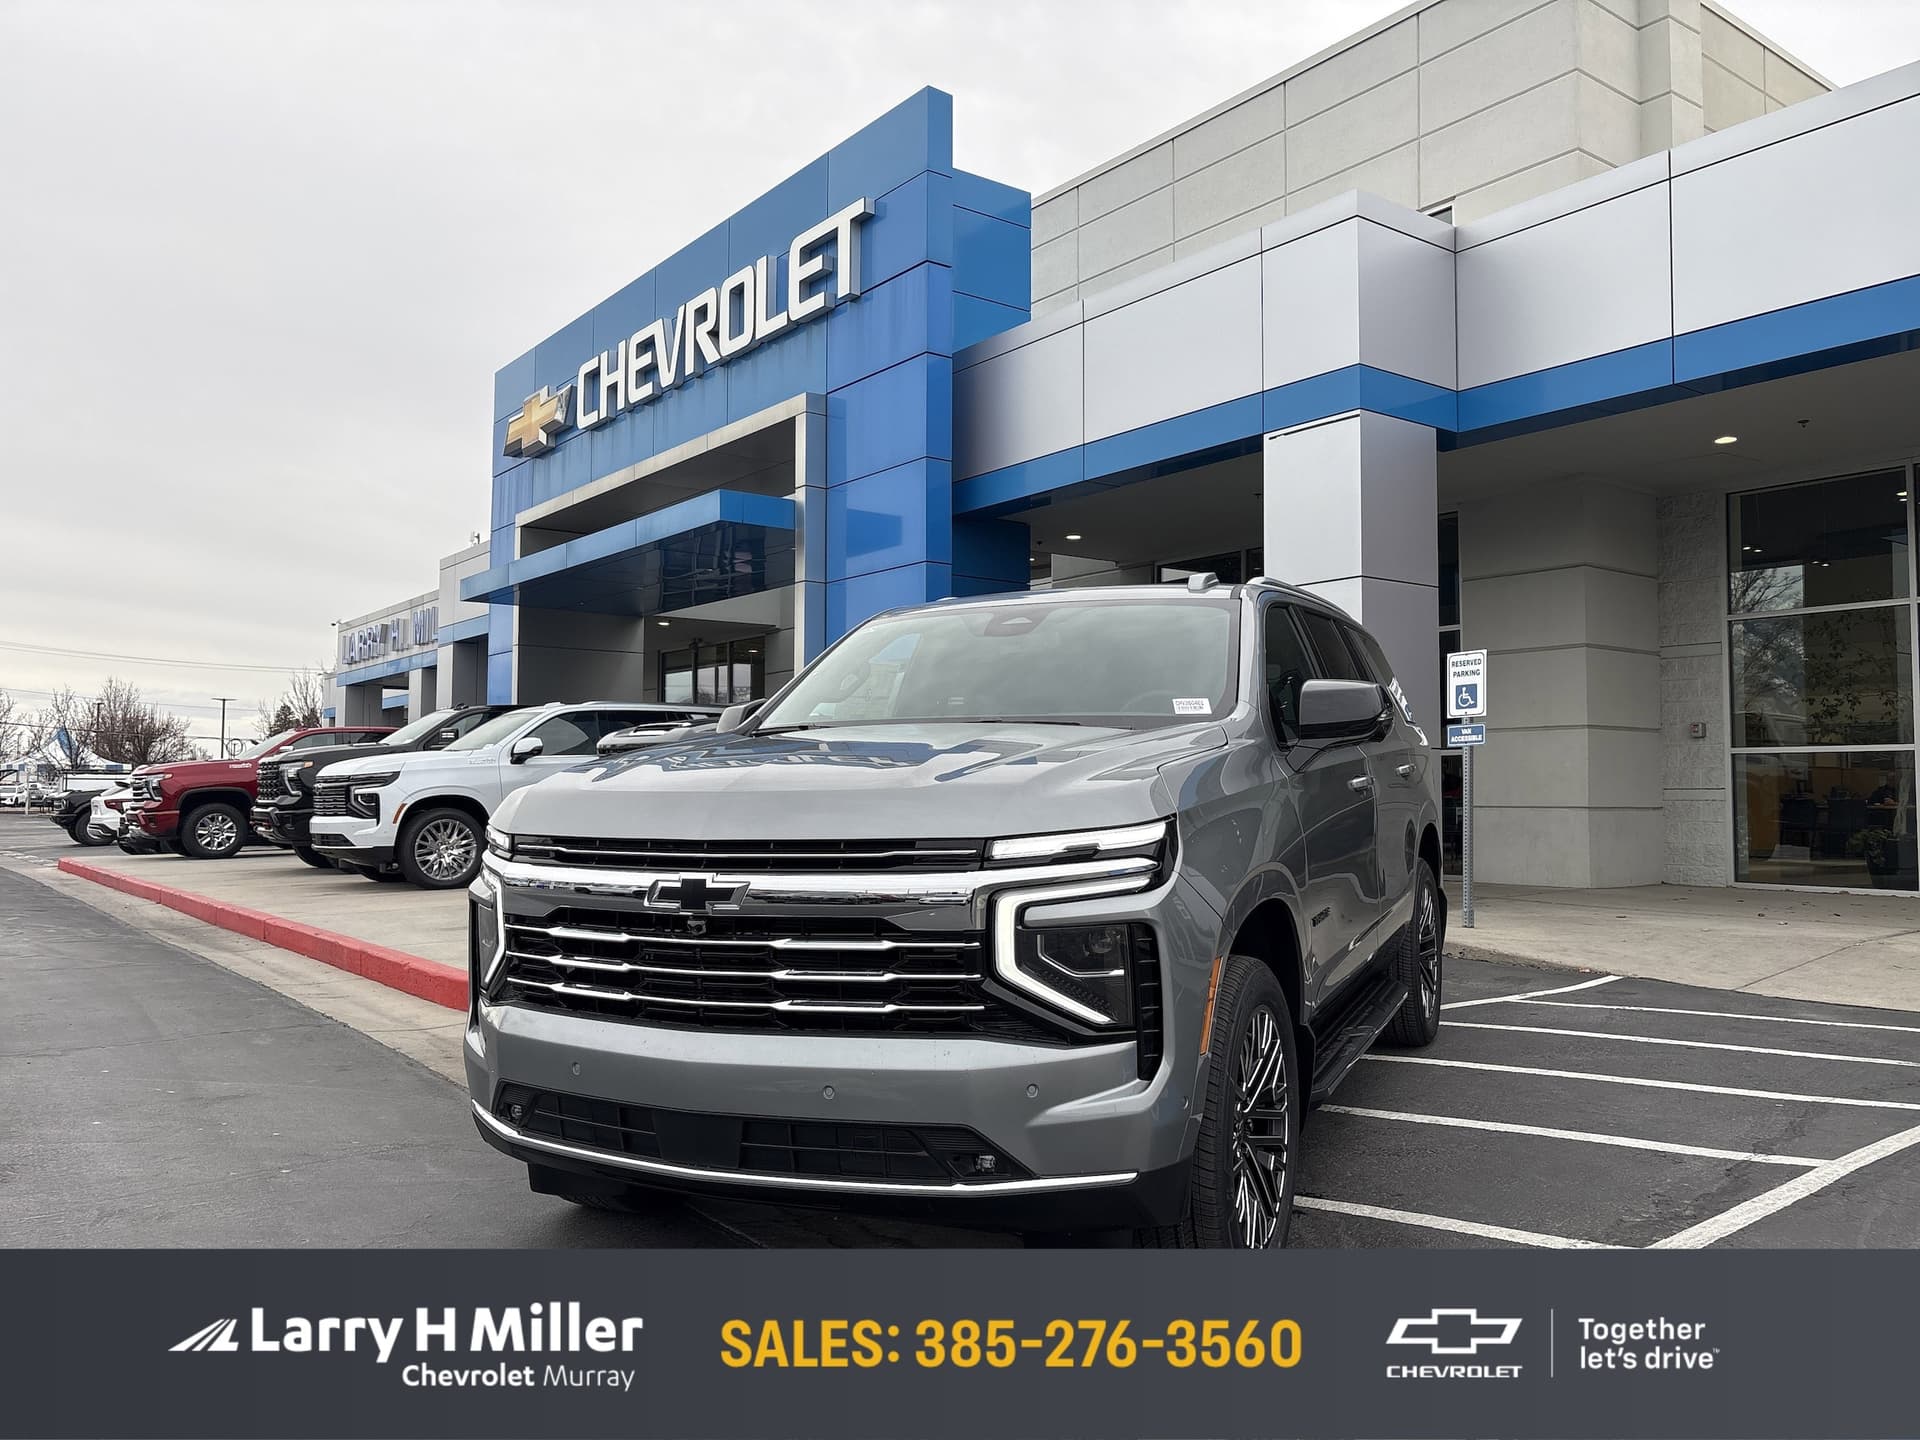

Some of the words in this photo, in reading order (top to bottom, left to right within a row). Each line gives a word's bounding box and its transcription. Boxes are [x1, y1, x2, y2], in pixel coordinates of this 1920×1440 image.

[576, 197, 872, 430] CHEVROLET
[342, 624, 386, 664] LARRY
[1451, 658, 1482, 668] RESERVED
[1453, 669, 1481, 678] PARKING
